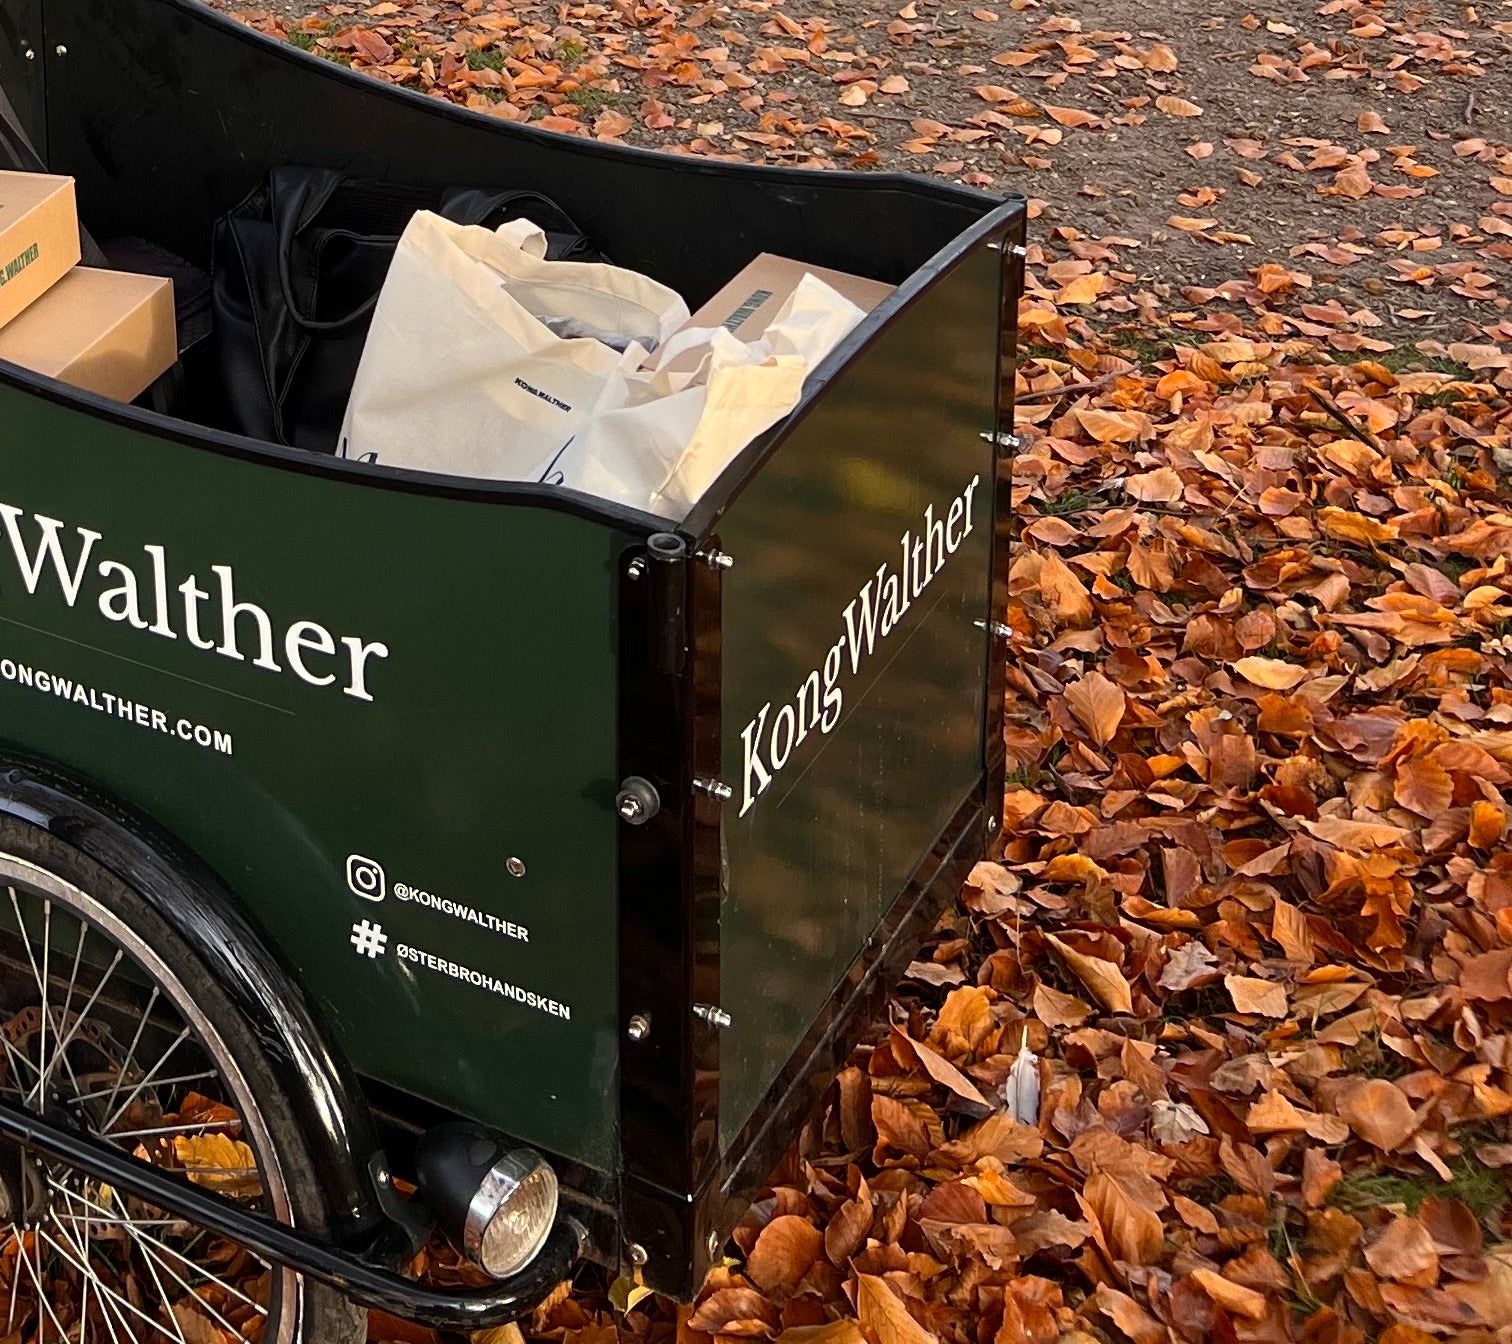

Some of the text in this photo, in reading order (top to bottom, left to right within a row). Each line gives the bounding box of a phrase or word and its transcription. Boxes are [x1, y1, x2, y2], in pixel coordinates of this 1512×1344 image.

[739, 474, 980, 818] KongWalther
[393, 882, 529, 943] @KONGWALTHER
[396, 943, 571, 1020] ØSTERBROHANDSKEN
